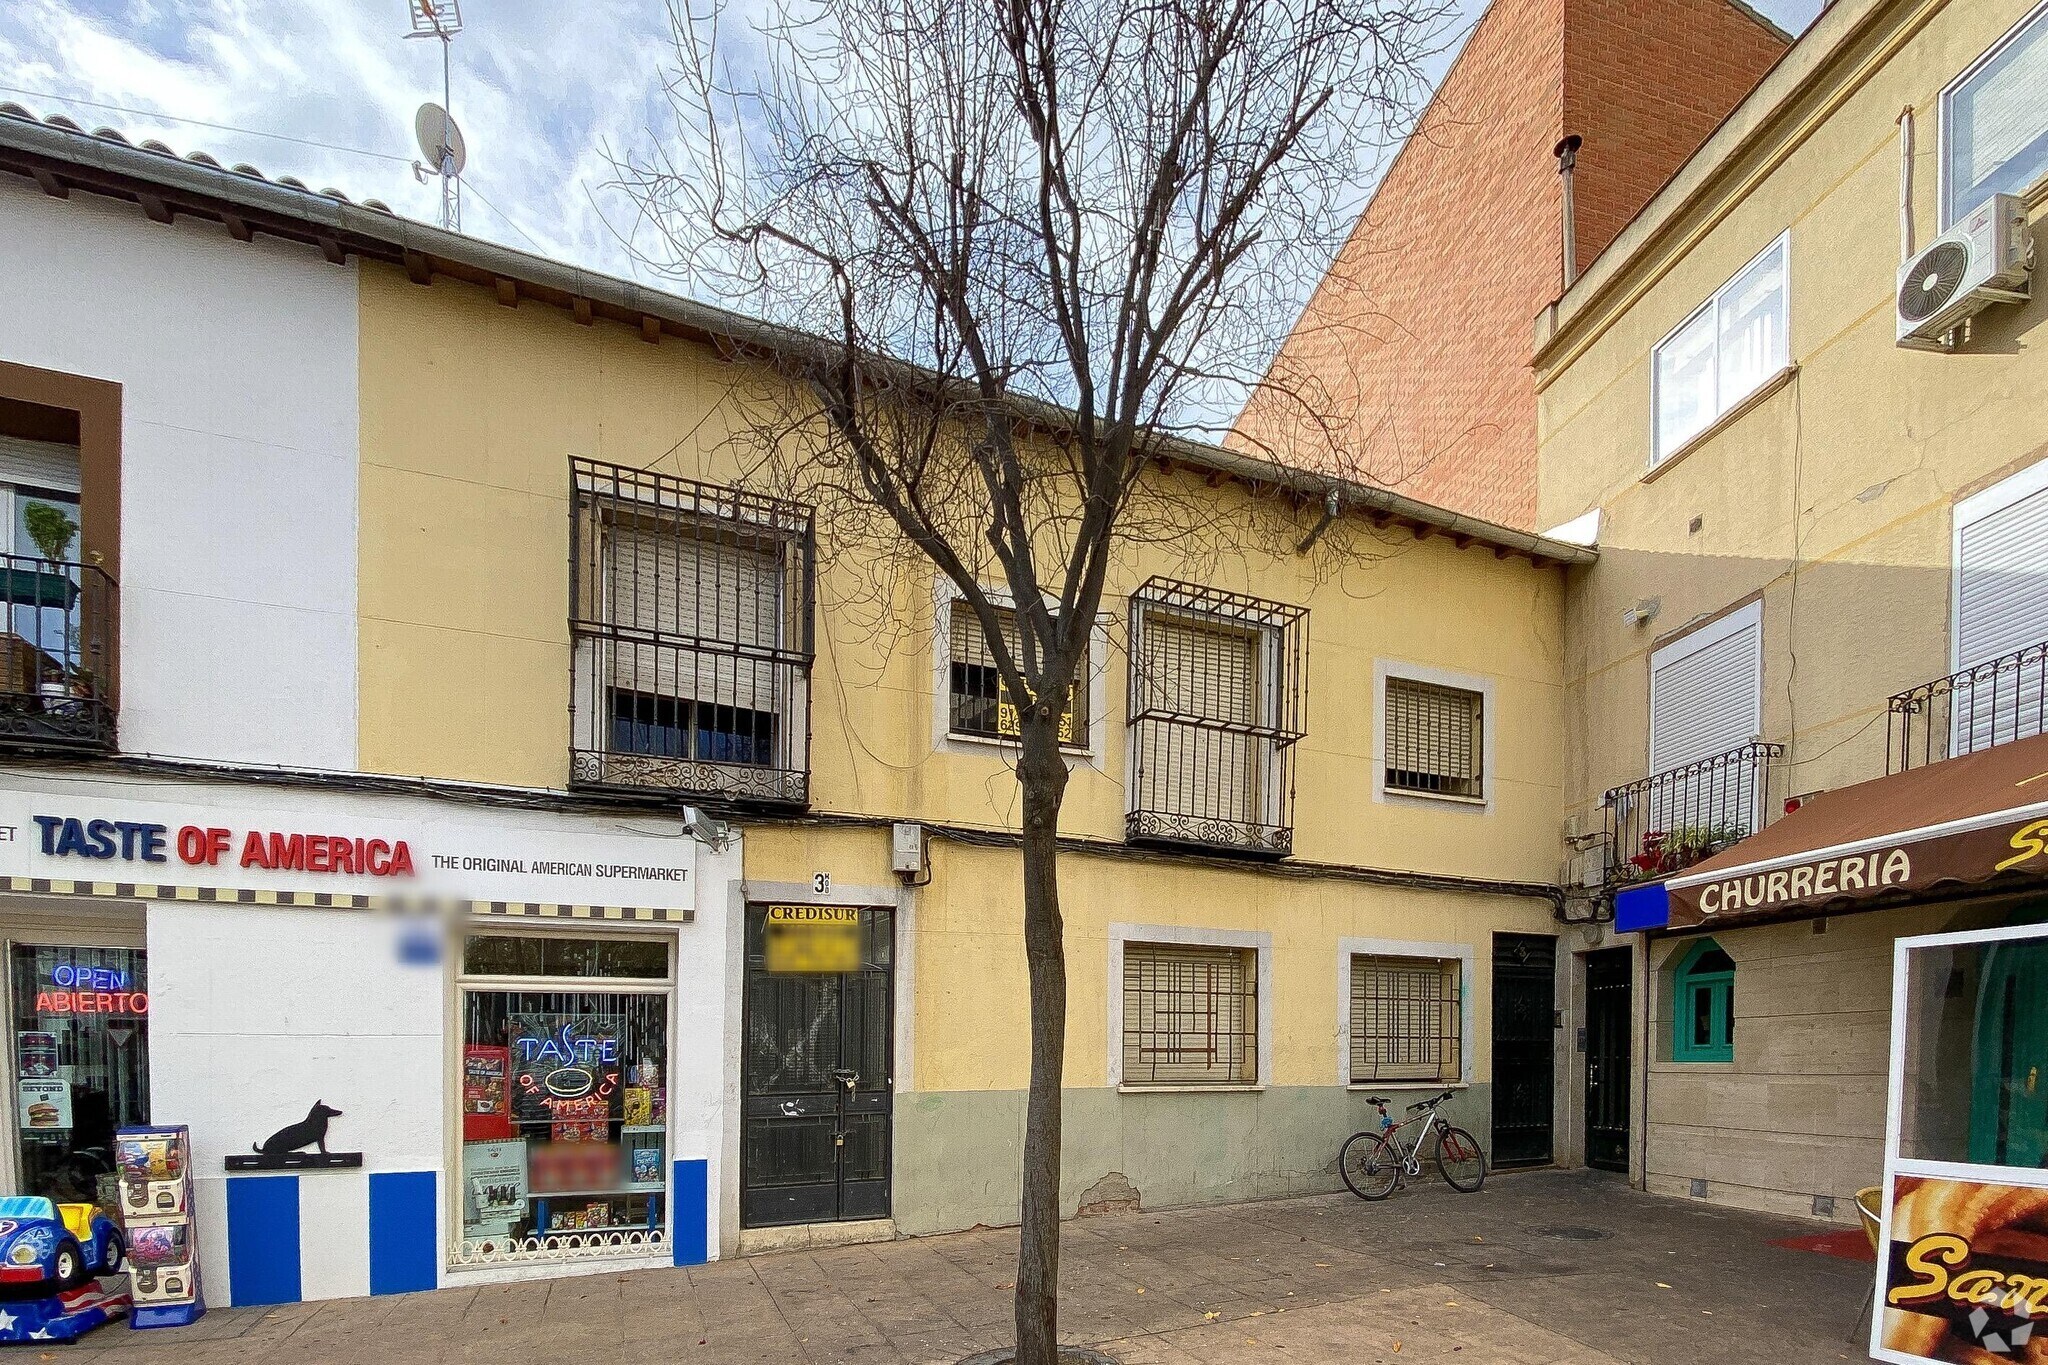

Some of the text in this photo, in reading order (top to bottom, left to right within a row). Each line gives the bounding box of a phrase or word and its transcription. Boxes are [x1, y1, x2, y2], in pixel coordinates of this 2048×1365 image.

[33, 815, 415, 877] TASTE OF AMERICA
[431, 855, 688, 882] THE ORIGINAL AMERICAN SUPERMARKET
[1699, 848, 1911, 914] CHURRERIA
[814, 873, 825, 893] 3
[770, 906, 857, 921] CREDISUR
[54, 964, 125, 990] OPEN
[36, 991, 149, 1014] ABIERTO
[516, 1023, 617, 1067] TASTE
[519, 1073, 619, 1113] OF AMERICA
